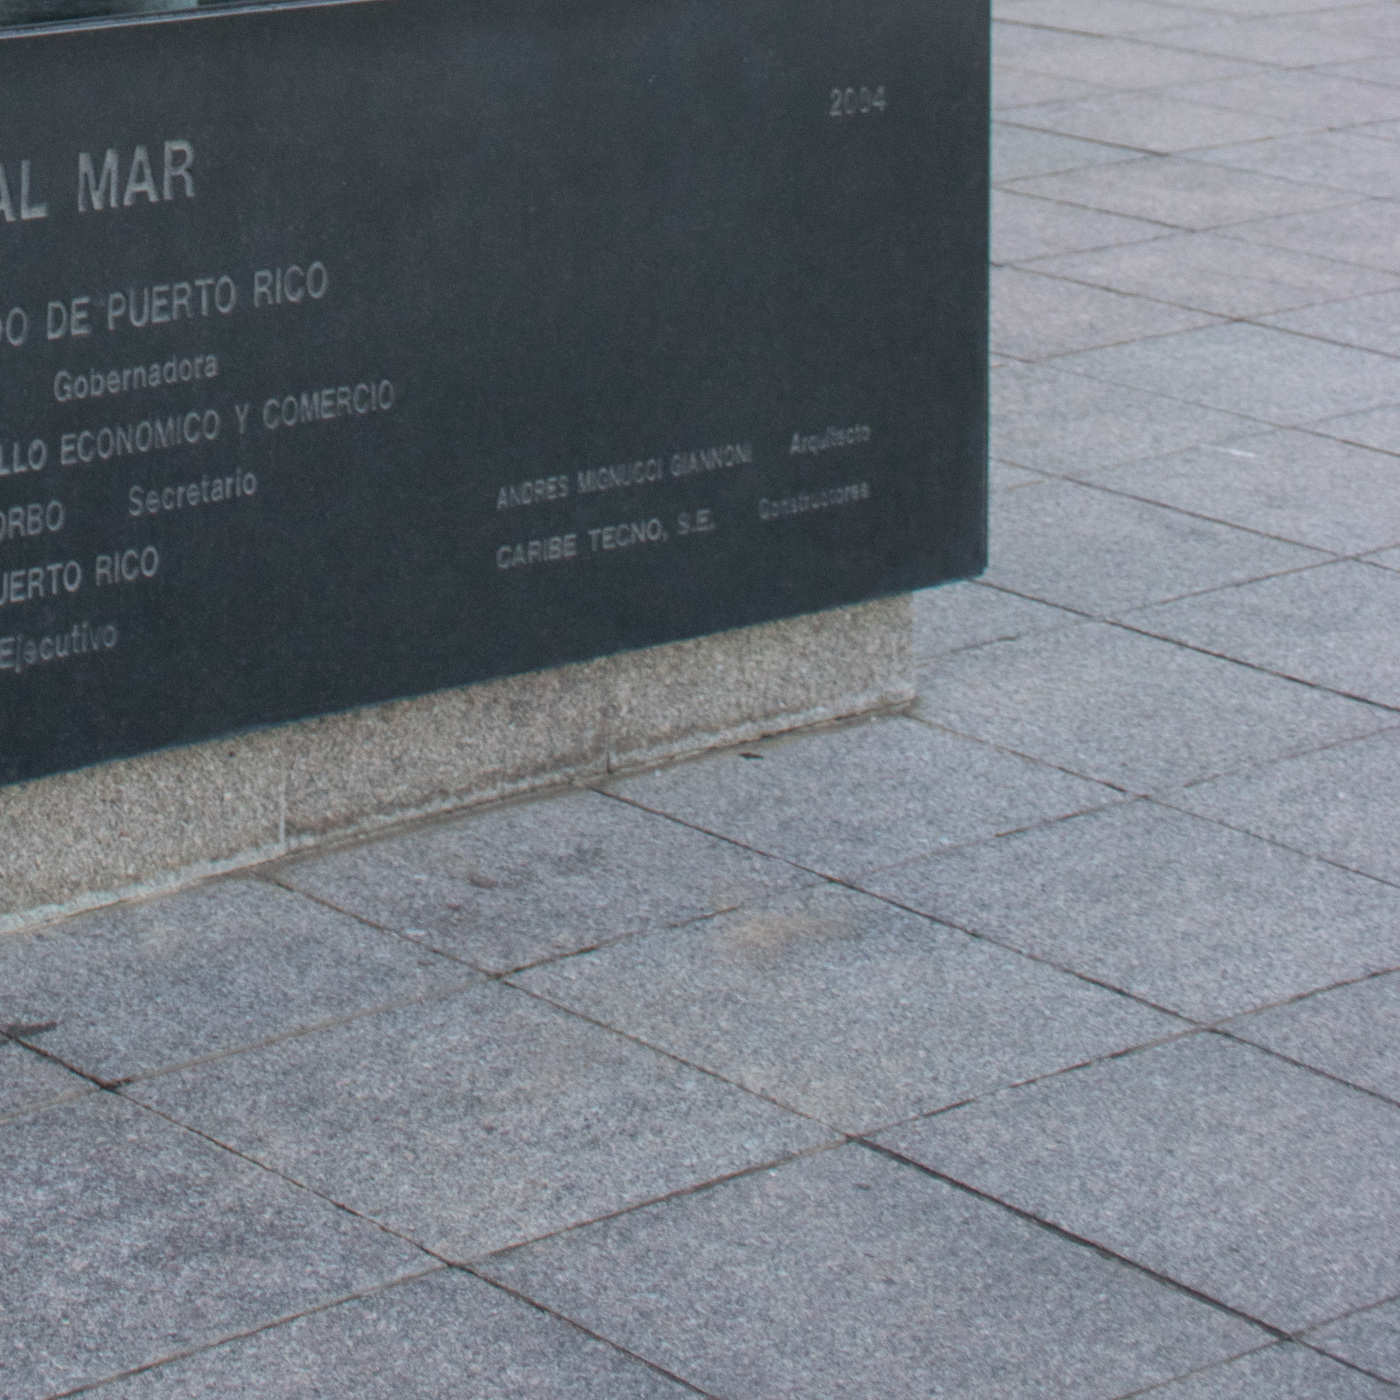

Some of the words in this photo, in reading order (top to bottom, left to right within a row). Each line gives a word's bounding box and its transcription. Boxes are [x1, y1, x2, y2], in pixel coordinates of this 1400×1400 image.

[77, 139, 197, 214] MAR
[47, 297, 91, 340] DE
[107, 275, 236, 330] PUERTO
[253, 261, 328, 308] RICO
[53, 353, 219, 402] Gobernadora
[61, 410, 221, 465] ECONOMICO
[235, 404, 251, 434] Y
[263, 379, 395, 430] COMERCIO
[128, 466, 257, 517] Secretario
[496, 474, 569, 510] ANDRES
[577, 457, 663, 494] MIGNUCCI
[95, 545, 159, 586] RICO
[496, 533, 577, 569] CARIBE
[588, 517, 668, 552] TECNO,
